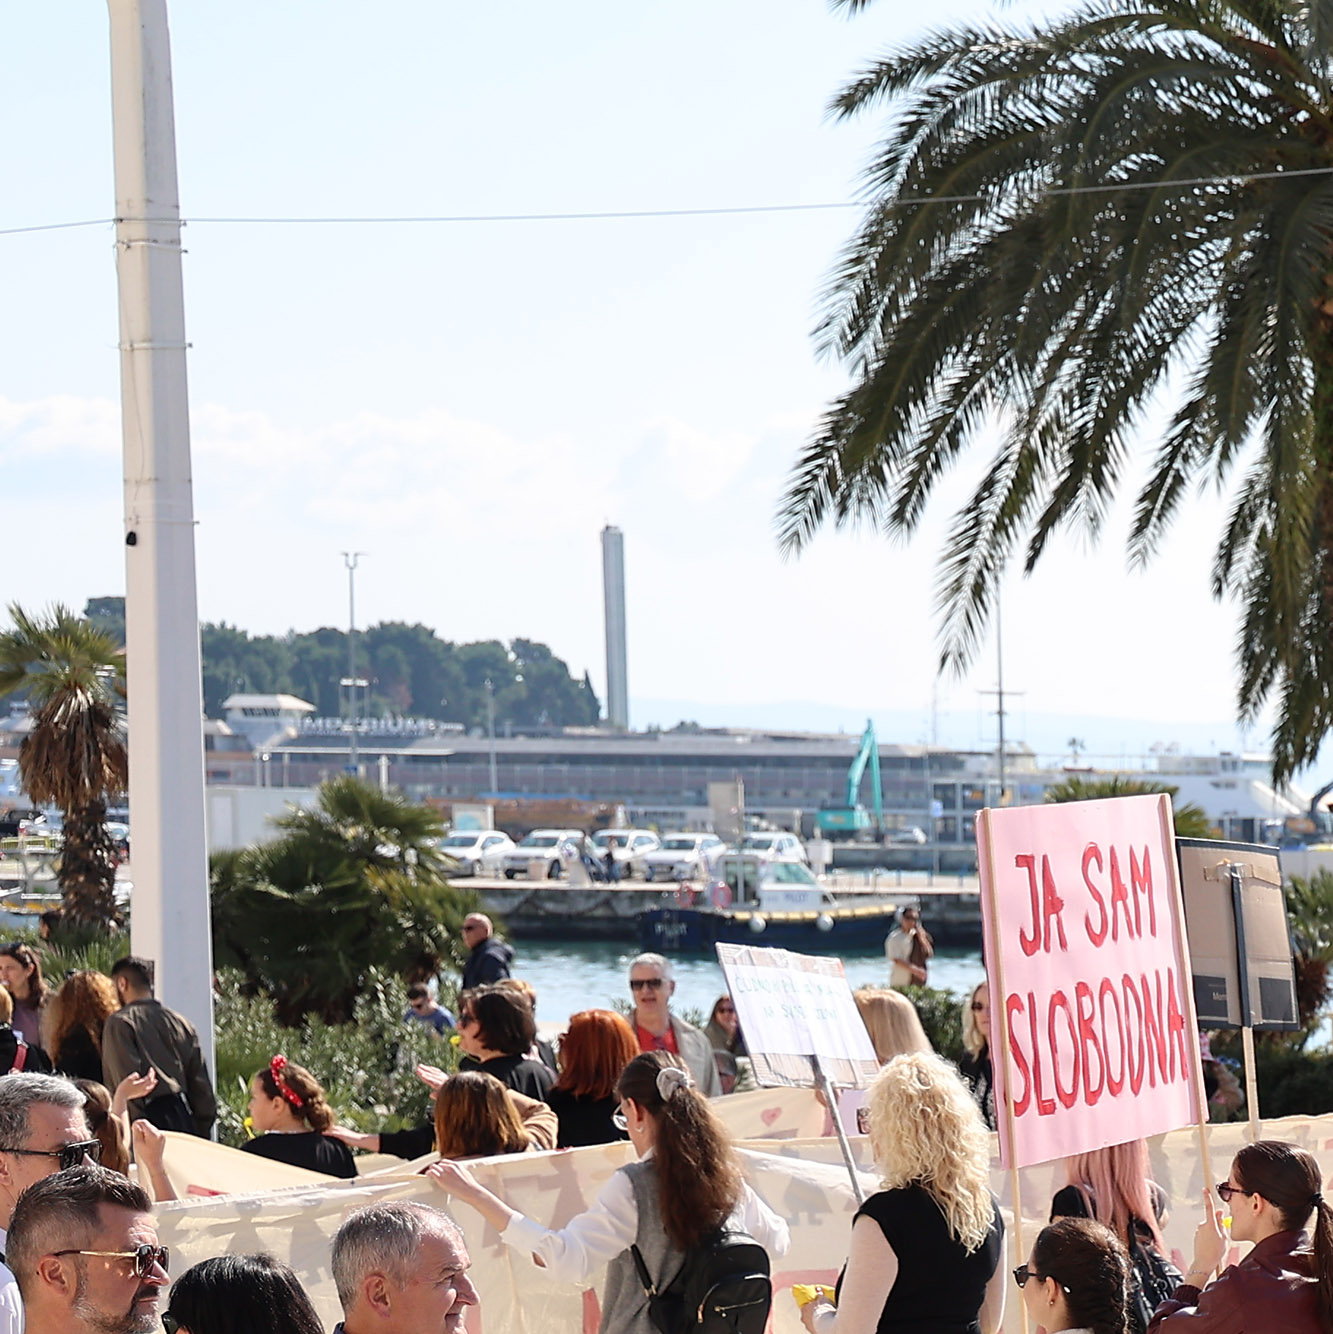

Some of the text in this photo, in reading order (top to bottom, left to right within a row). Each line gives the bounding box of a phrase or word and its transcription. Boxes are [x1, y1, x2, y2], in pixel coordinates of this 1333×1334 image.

[1015, 842, 1156, 957] JA SAM
[1004, 967, 1189, 1117] SLOBODNA
